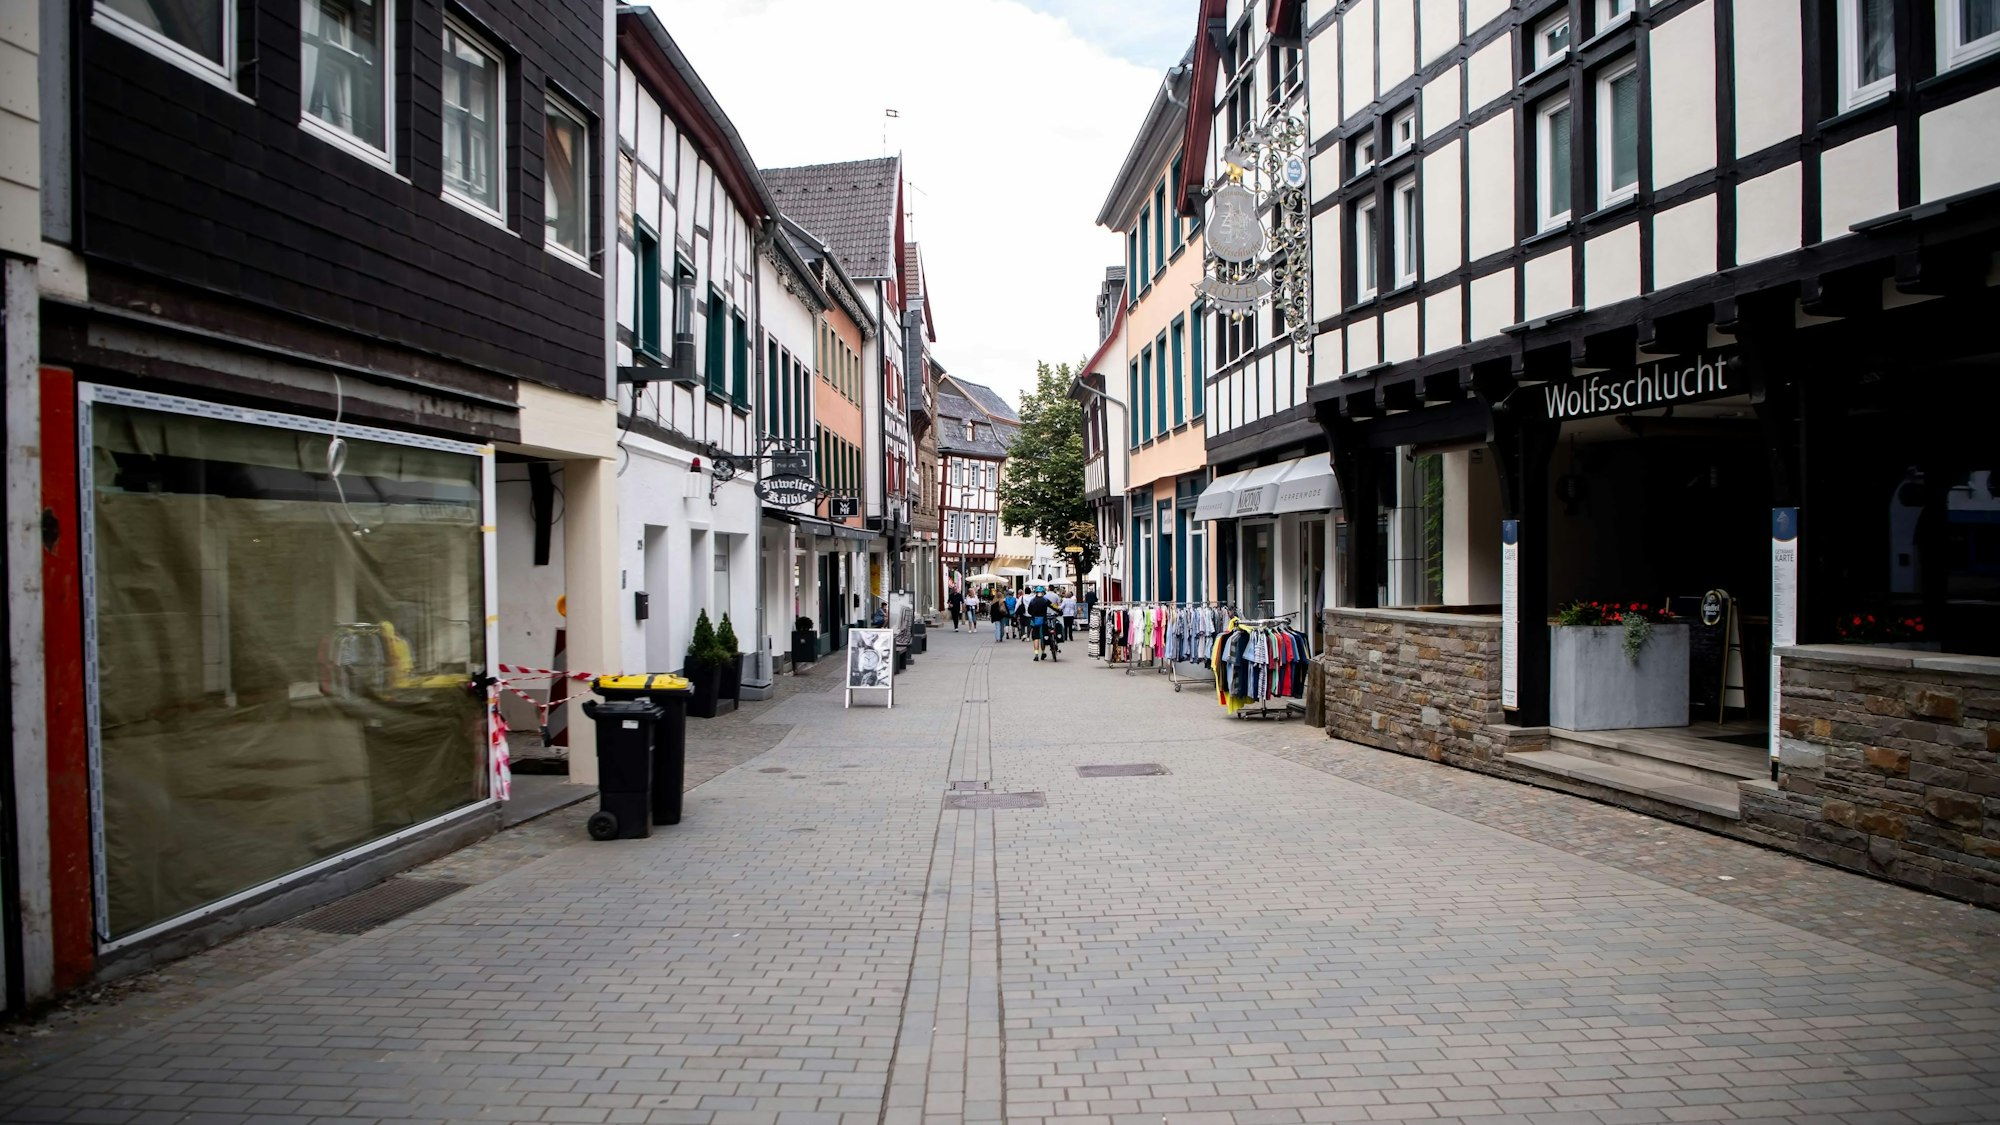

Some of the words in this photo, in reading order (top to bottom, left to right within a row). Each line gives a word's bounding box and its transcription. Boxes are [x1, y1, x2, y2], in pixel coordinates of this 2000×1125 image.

[1208, 285, 1263, 299] HOTEL
[1545, 354, 1728, 418] Wolfsschlucht
[760, 479, 815, 493] Juwelier
[766, 490, 808, 504] Kälble
[1280, 488, 1321, 501] HERRENMODE
